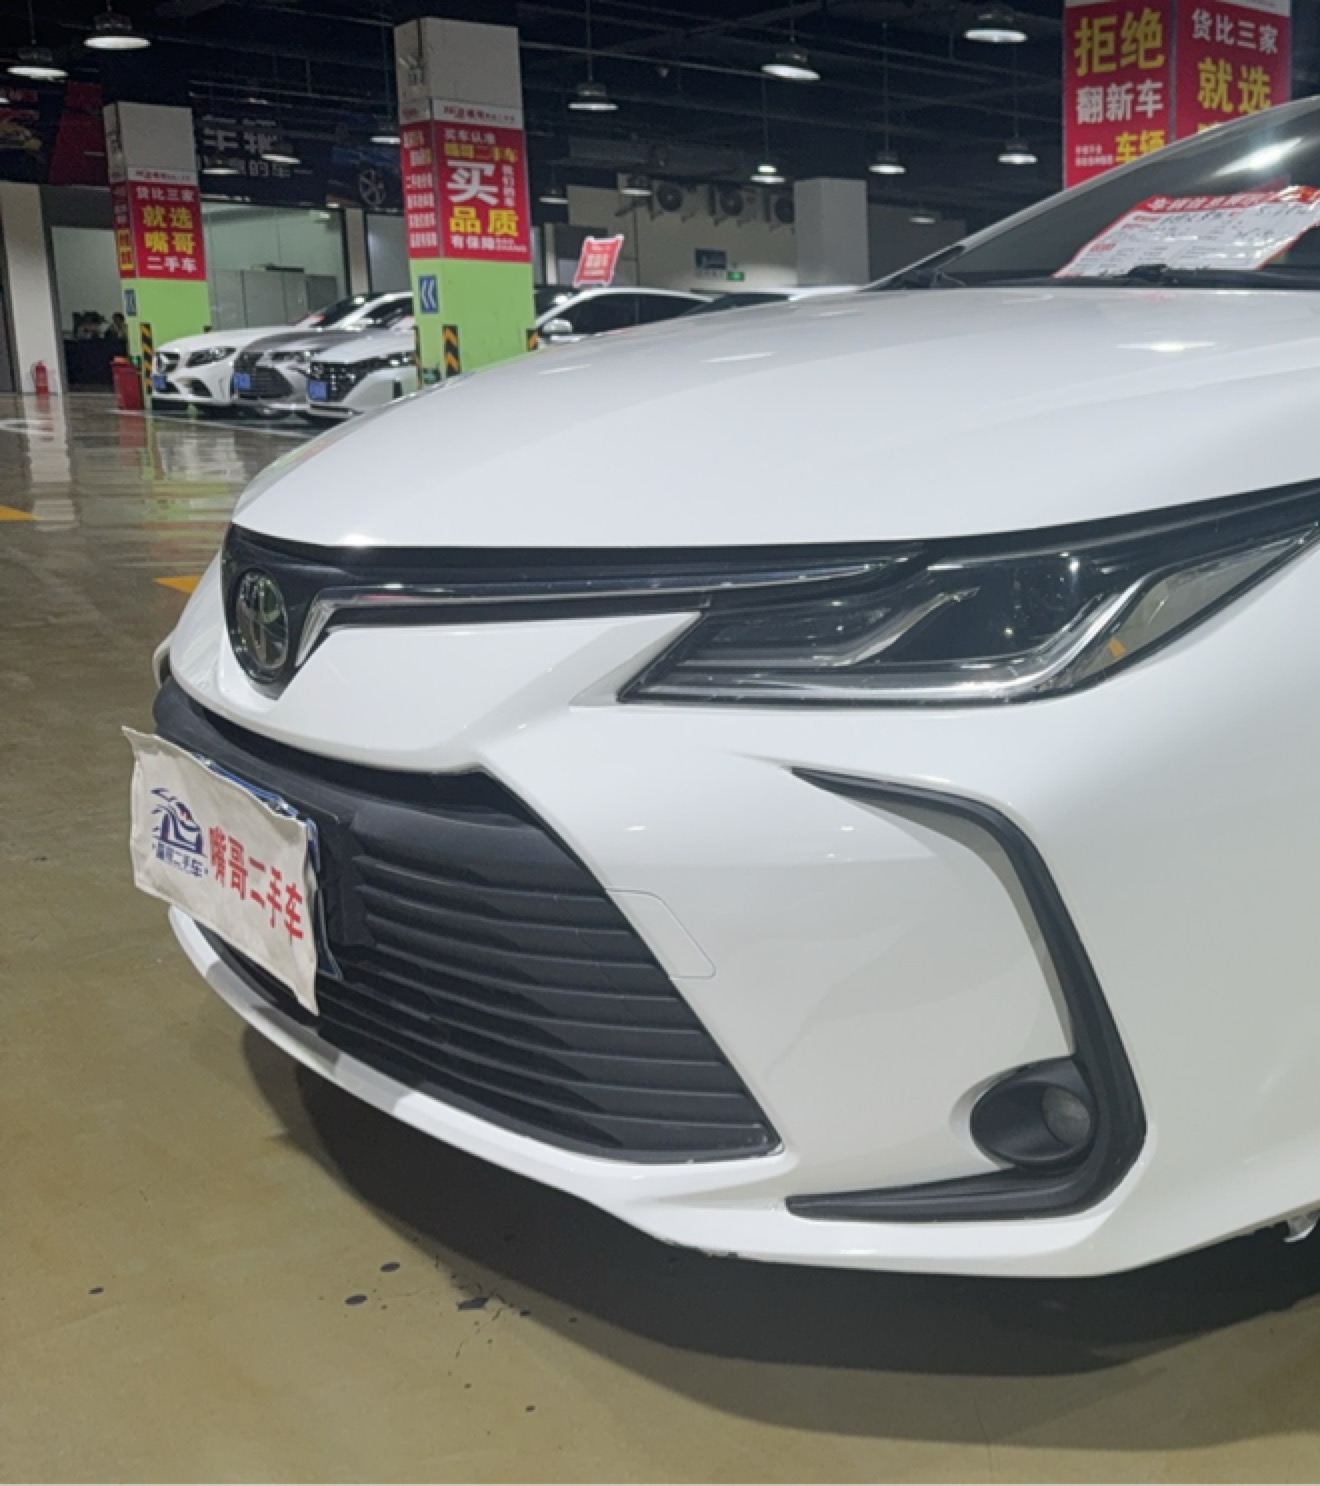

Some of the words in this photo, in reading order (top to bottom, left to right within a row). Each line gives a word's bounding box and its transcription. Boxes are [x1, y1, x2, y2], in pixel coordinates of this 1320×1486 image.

[1074, 7, 1165, 77] 拒绝
[1191, 8, 1278, 54] 货比三家
[1076, 79, 1163, 125] 翻新车
[1197, 56, 1271, 113] 就选
[136, 185, 195, 202] 货比三家
[446, 159, 499, 206] 买
[142, 205, 193, 228] 就选
[450, 206, 518, 236] 品质
[144, 231, 196, 254] 嘴哥
[146, 255, 197, 273] 二手车
[209, 825, 303, 946] 嘴哥二手车
